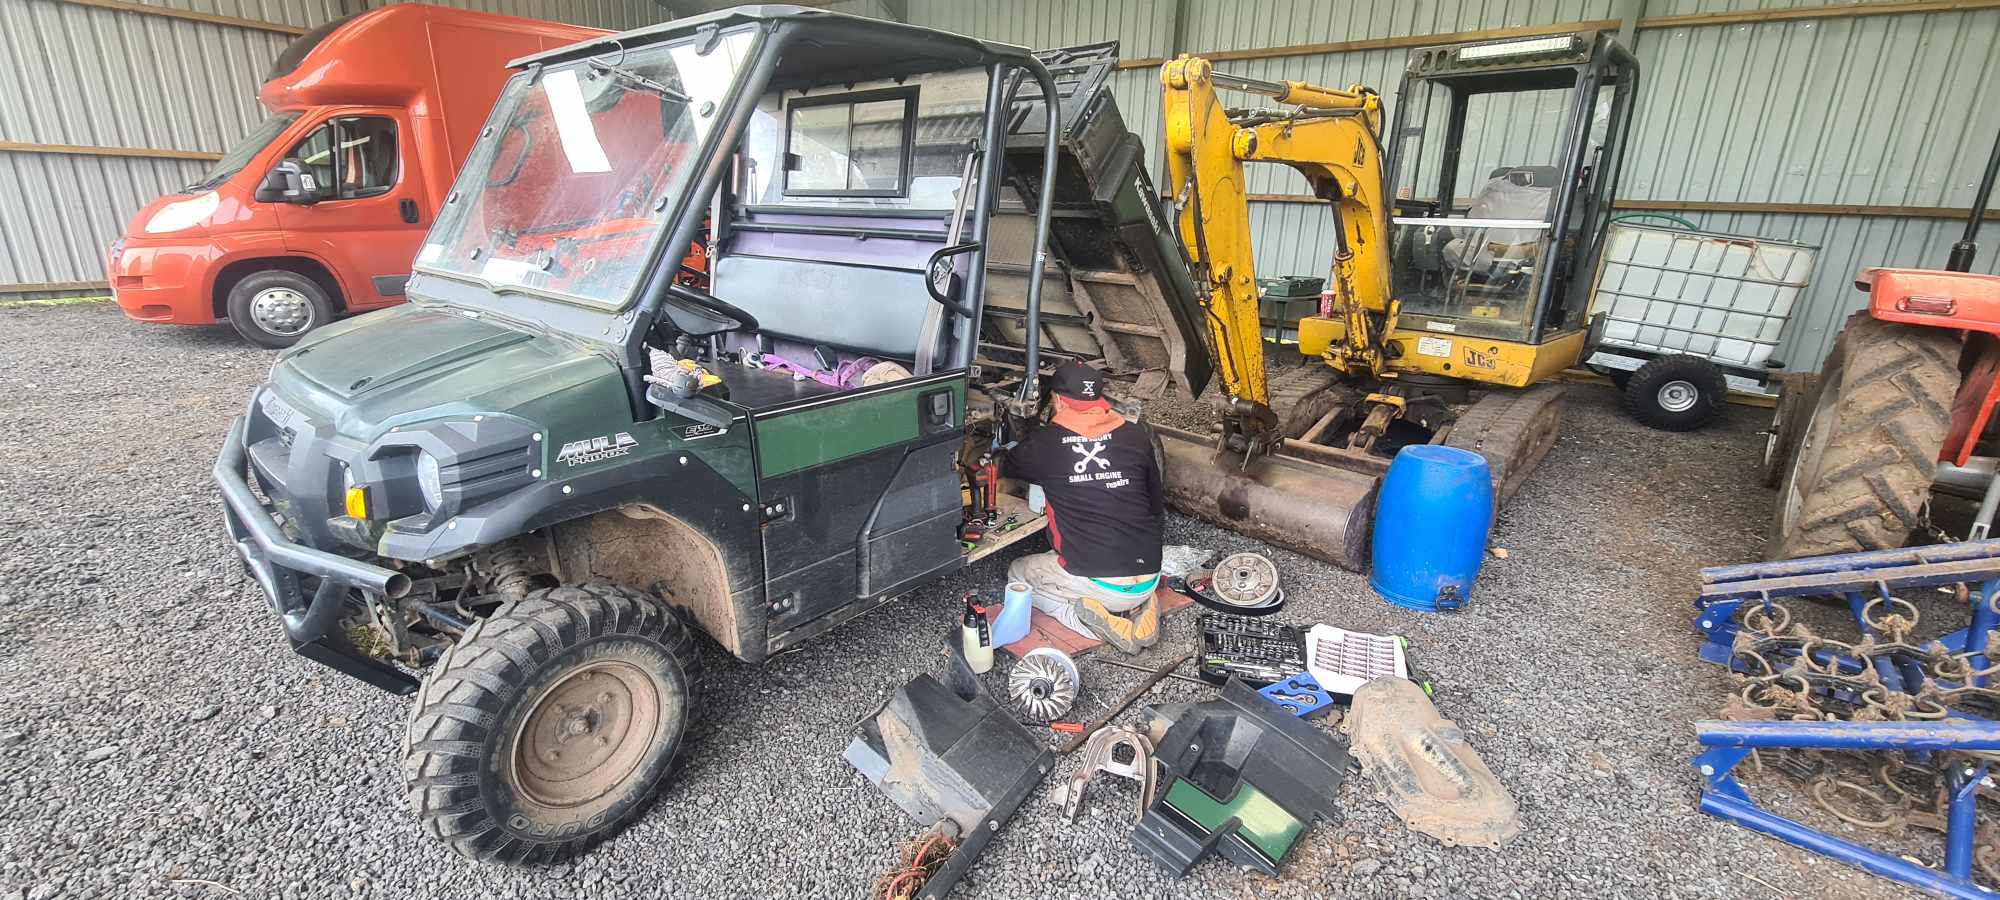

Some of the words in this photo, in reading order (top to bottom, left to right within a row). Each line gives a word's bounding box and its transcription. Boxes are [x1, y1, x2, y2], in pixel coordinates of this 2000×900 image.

[1069, 473, 1094, 482] SMALL
[1095, 471, 1122, 480] ENGINE
[507, 809, 608, 837] DURO
